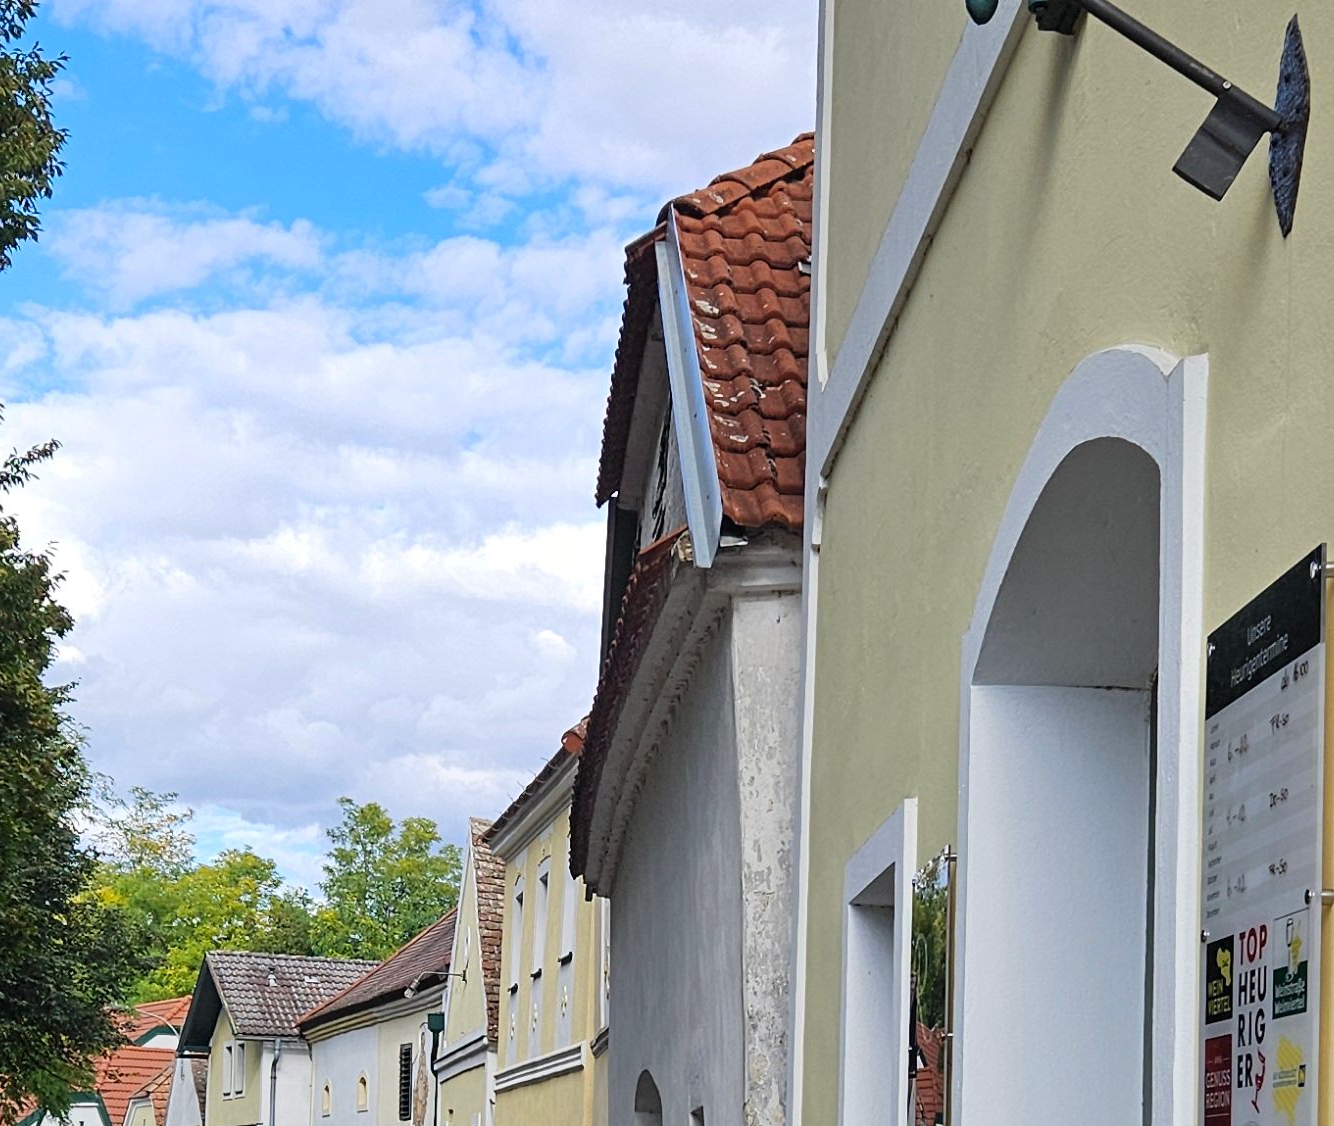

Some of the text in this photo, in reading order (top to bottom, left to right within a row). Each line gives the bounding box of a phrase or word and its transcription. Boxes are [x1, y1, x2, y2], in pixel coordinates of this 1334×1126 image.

[1247, 615, 1271, 646] Unsere
[1230, 633, 1288, 688] Heurigentermine
[1239, 924, 1267, 966] TOP
[1208, 978, 1224, 999] WEIN
[1238, 965, 1267, 1007] HEU
[1208, 995, 1231, 1016] VIERTEL
[1238, 1007, 1266, 1048] RIG
[1206, 1068, 1231, 1089] GENUSS
[1237, 1053, 1253, 1089] ER
[1205, 1089, 1230, 1109] REGION
